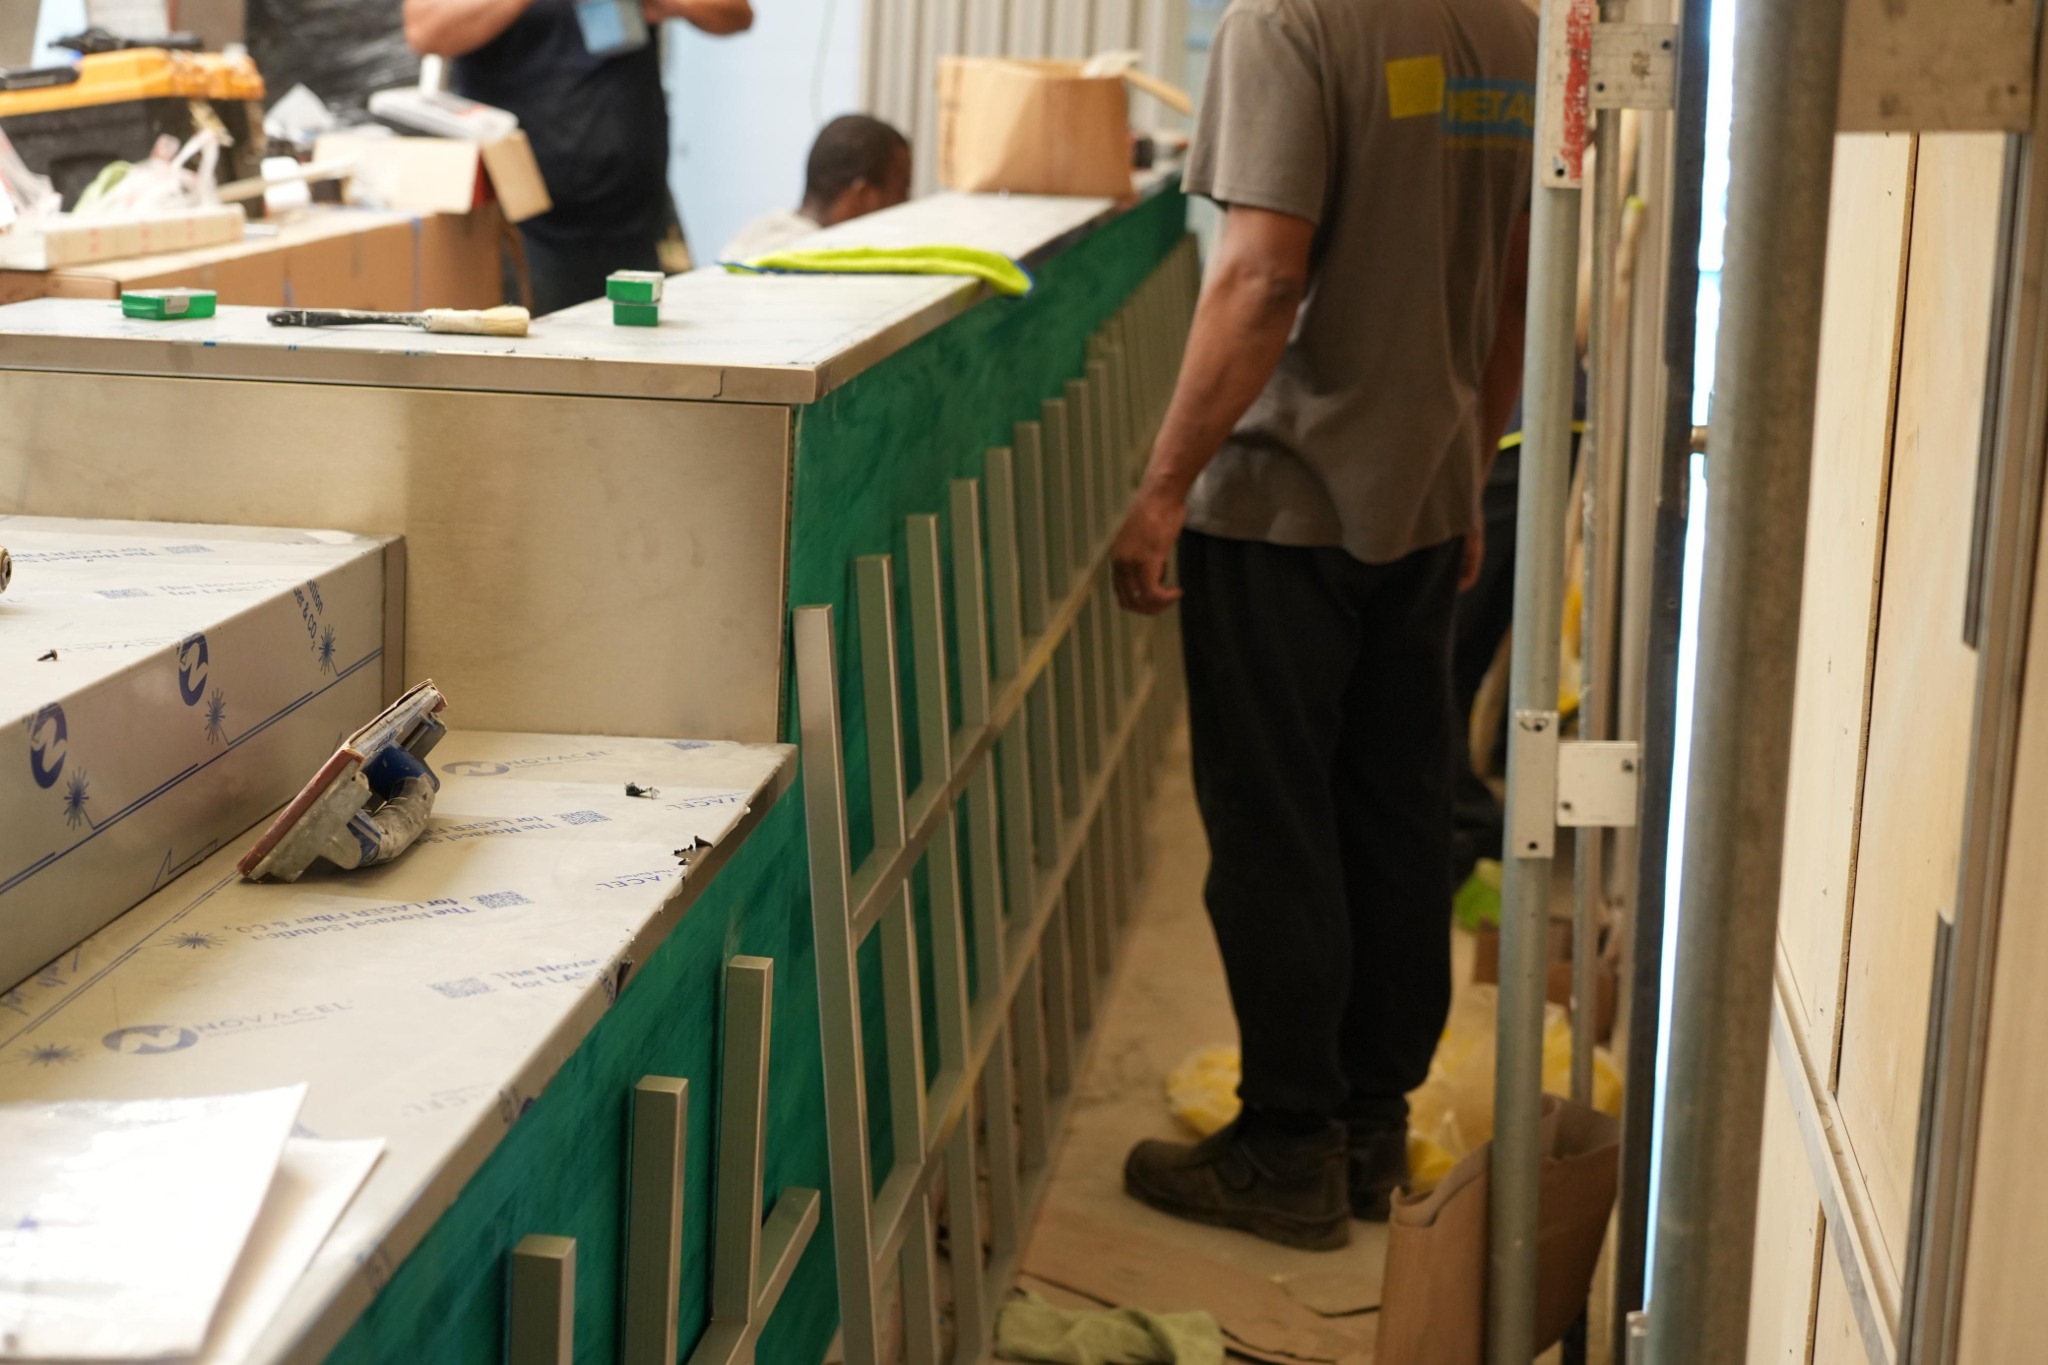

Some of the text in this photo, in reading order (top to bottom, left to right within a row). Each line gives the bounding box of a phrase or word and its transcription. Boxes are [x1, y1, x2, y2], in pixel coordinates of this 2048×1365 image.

[1446, 88, 1535, 128] META
[446, 827, 522, 842] Novacel
[523, 823, 559, 831] The
[353, 902, 425, 918] LASER
[434, 906, 476, 917] The
[295, 912, 350, 925] Fiber
[349, 912, 433, 930] Novacel
